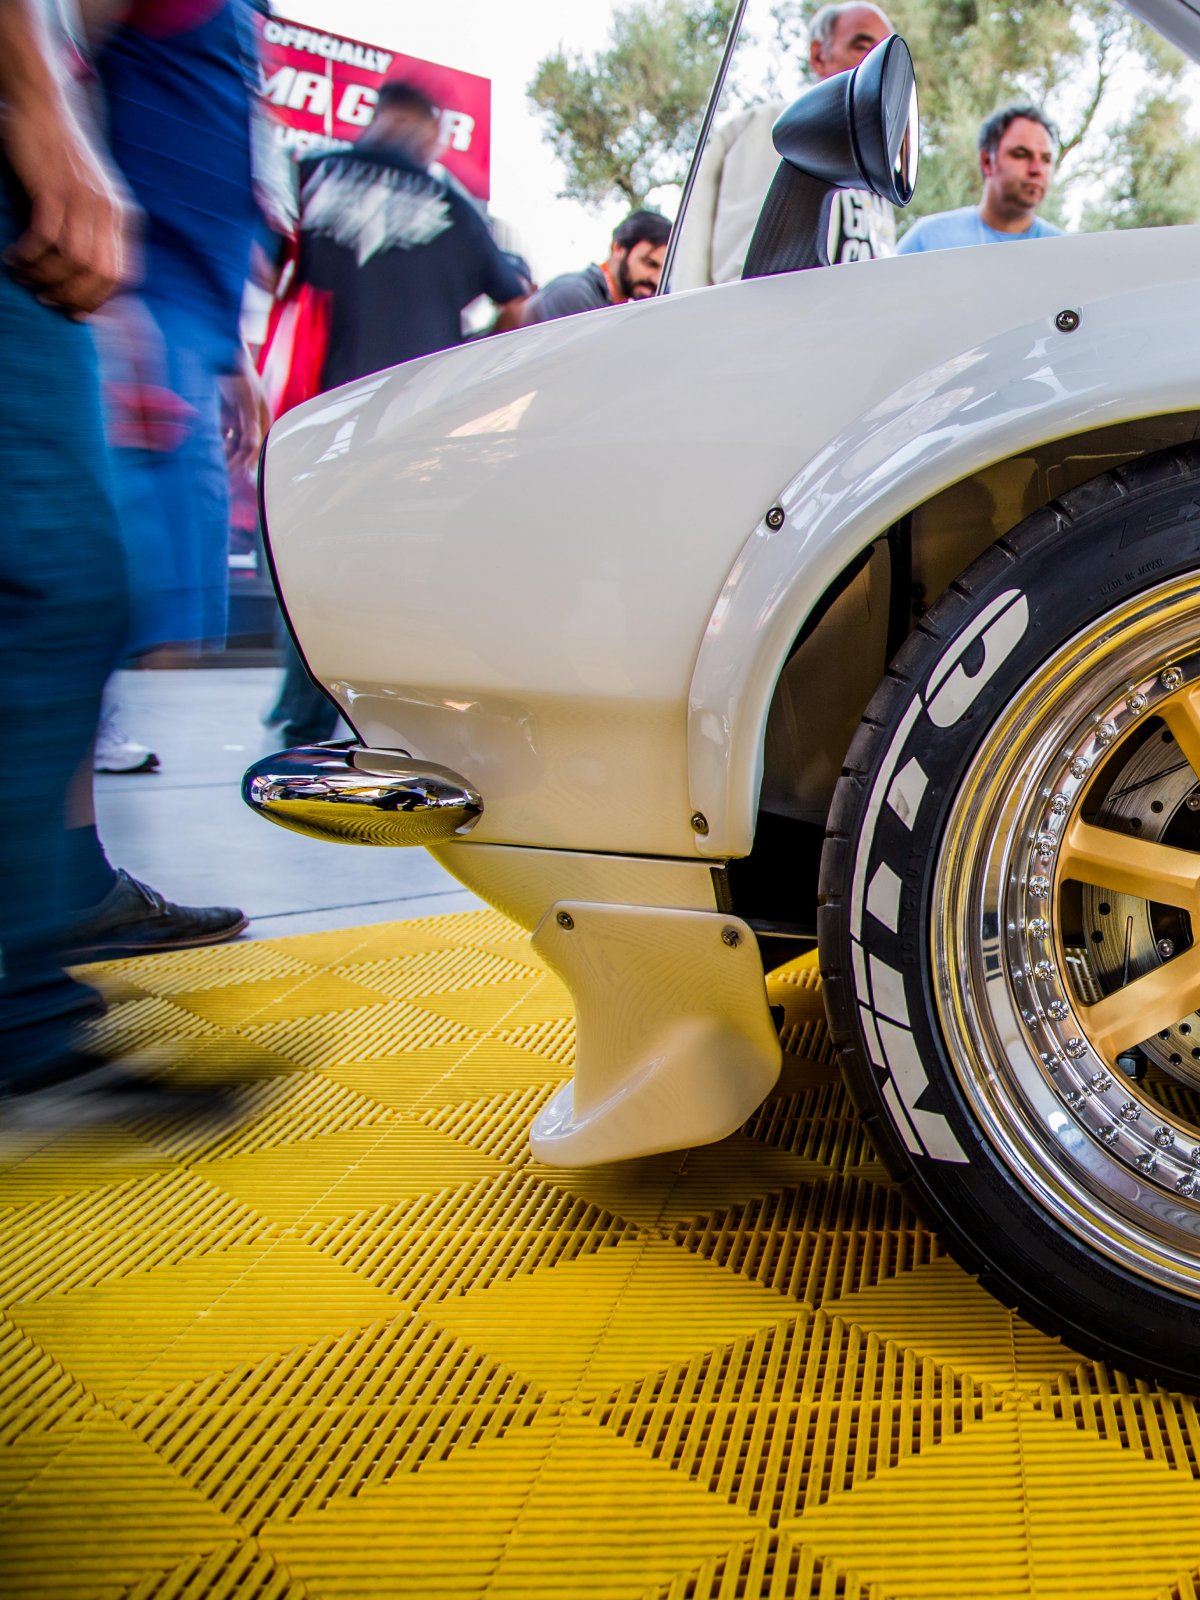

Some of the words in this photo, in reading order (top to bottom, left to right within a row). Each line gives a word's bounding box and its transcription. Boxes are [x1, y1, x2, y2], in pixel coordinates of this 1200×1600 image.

[263, 21, 392, 74] OFFICIALLY
[336, 83, 475, 152] GR
[1100, 576, 1124, 595] MADE
[1135, 557, 1165, 576] JAPAN
